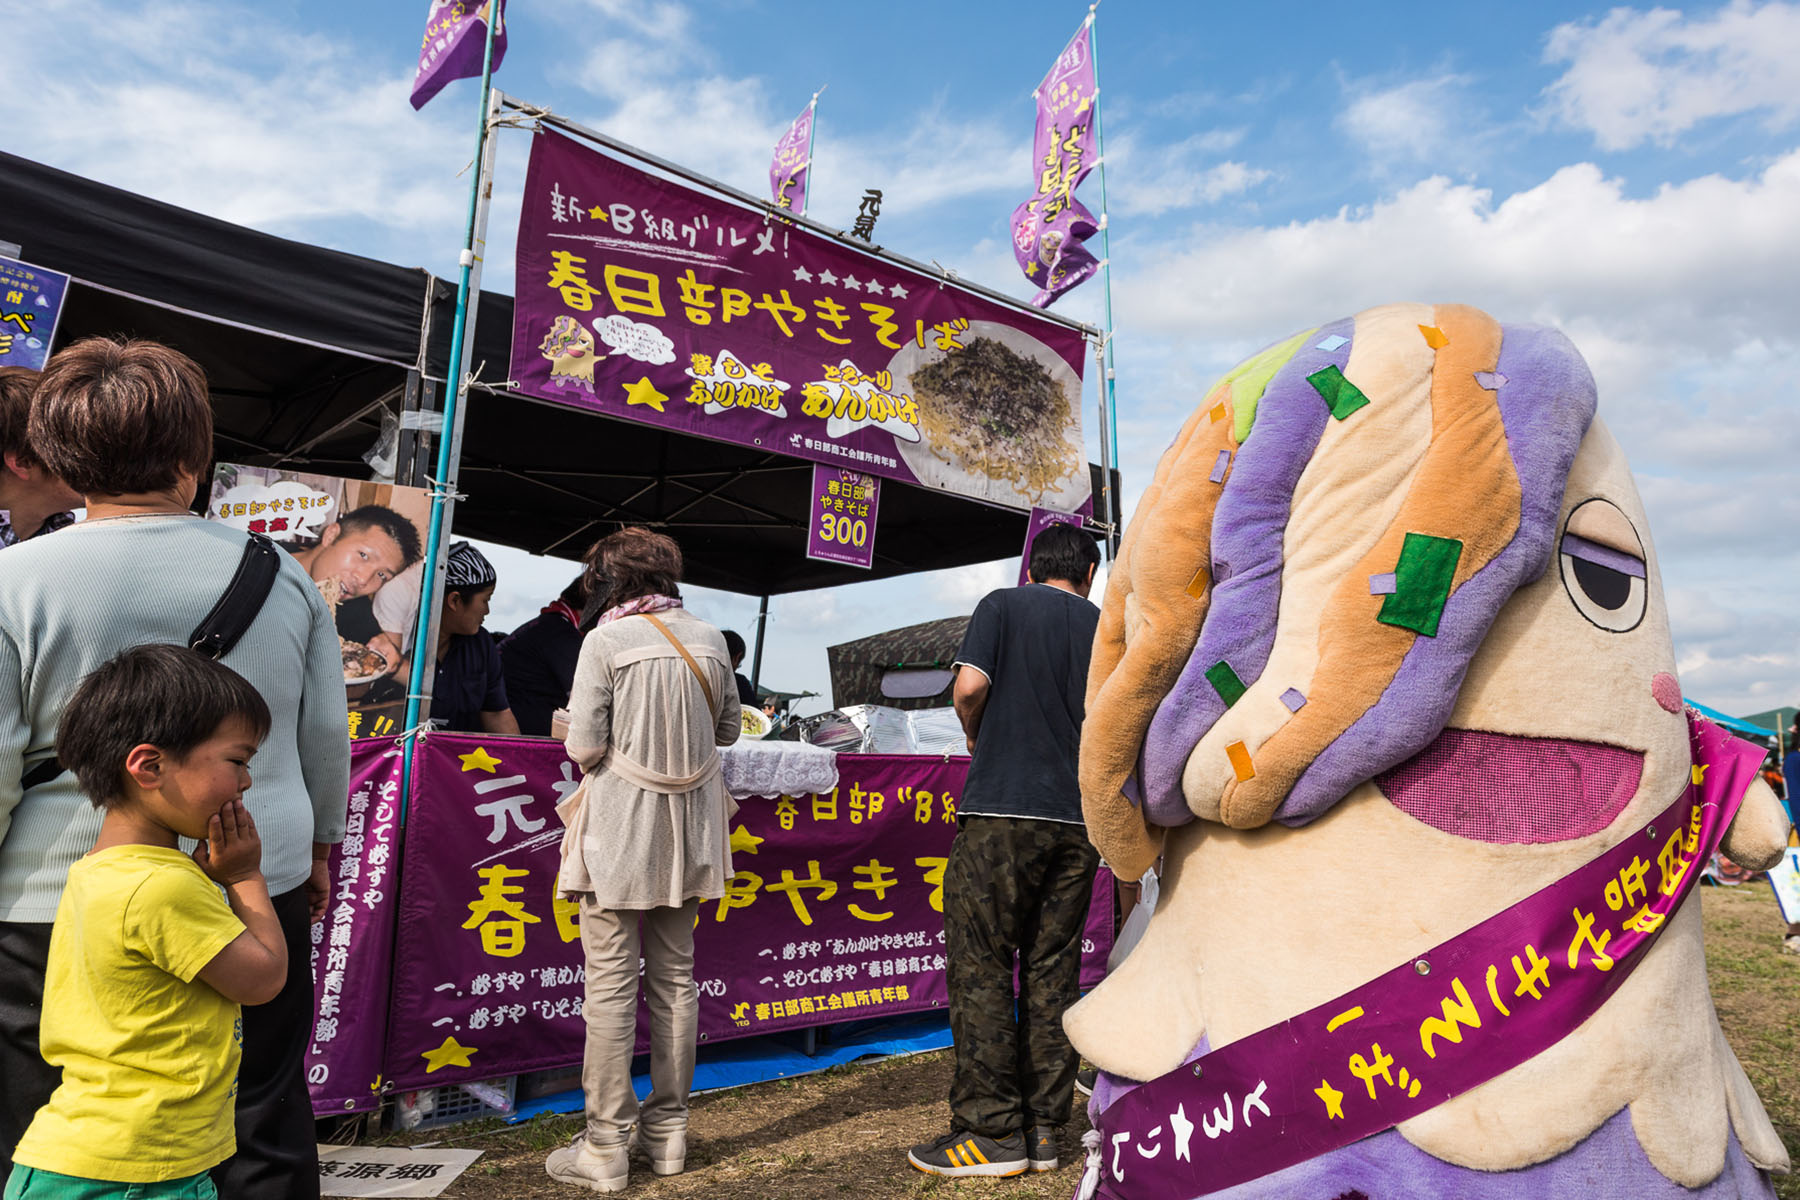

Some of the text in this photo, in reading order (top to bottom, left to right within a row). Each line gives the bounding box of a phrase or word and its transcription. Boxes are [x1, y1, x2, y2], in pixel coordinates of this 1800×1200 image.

[546, 250, 971, 350] 春日部やきそば
[685, 378, 785, 411] ふりかけ
[800, 382, 920, 426] あんかけ
[820, 495, 870, 518] やきそば
[827, 480, 866, 501] 春日部
[819, 512, 867, 548] 300
[755, 984, 910, 1021] 春日部商工会議所青年部
